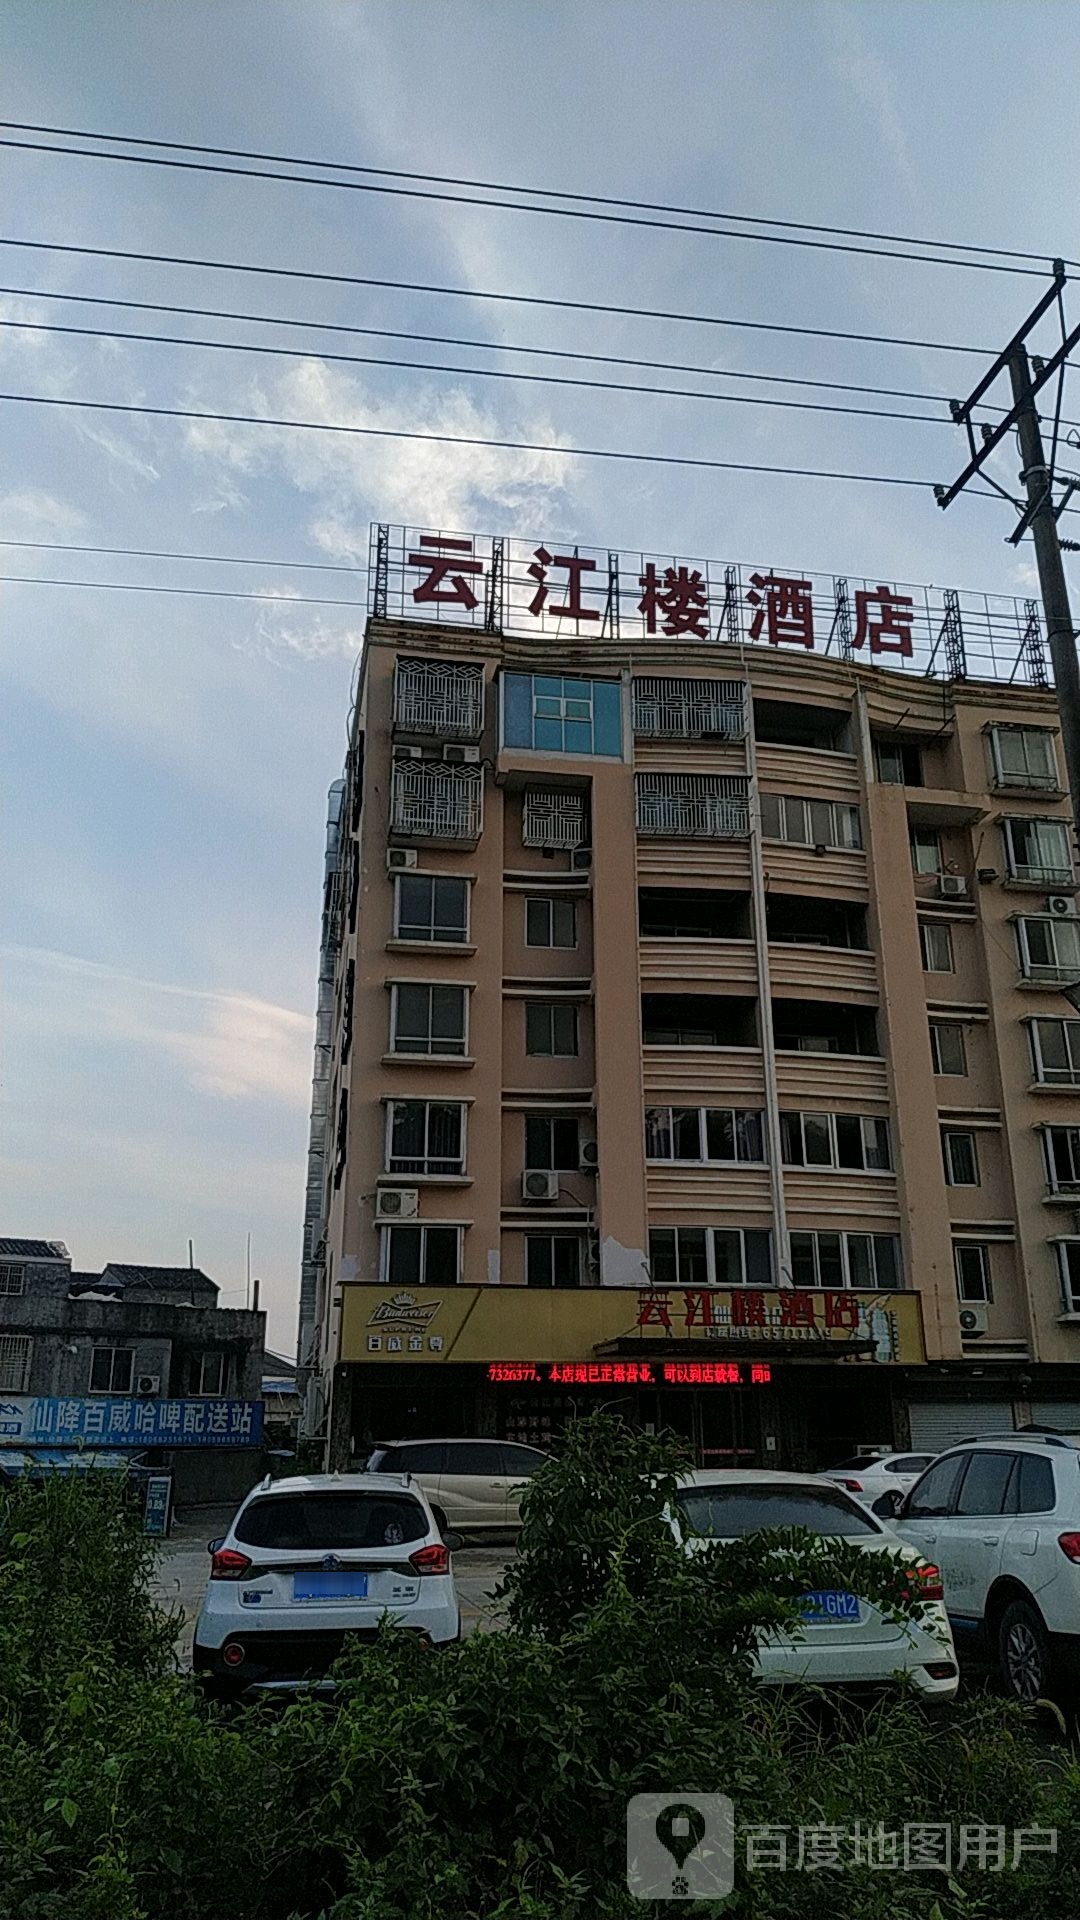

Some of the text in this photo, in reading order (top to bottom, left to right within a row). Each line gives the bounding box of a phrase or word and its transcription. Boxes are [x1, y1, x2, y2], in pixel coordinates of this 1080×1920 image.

[408, 535, 915, 658] 云江楼酒店
[376, 1306, 434, 1319] Budweiser
[368, 1335, 443, 1352] 百威金尊
[31, 1399, 253, 1434] 仙降百威哈啤配送站
